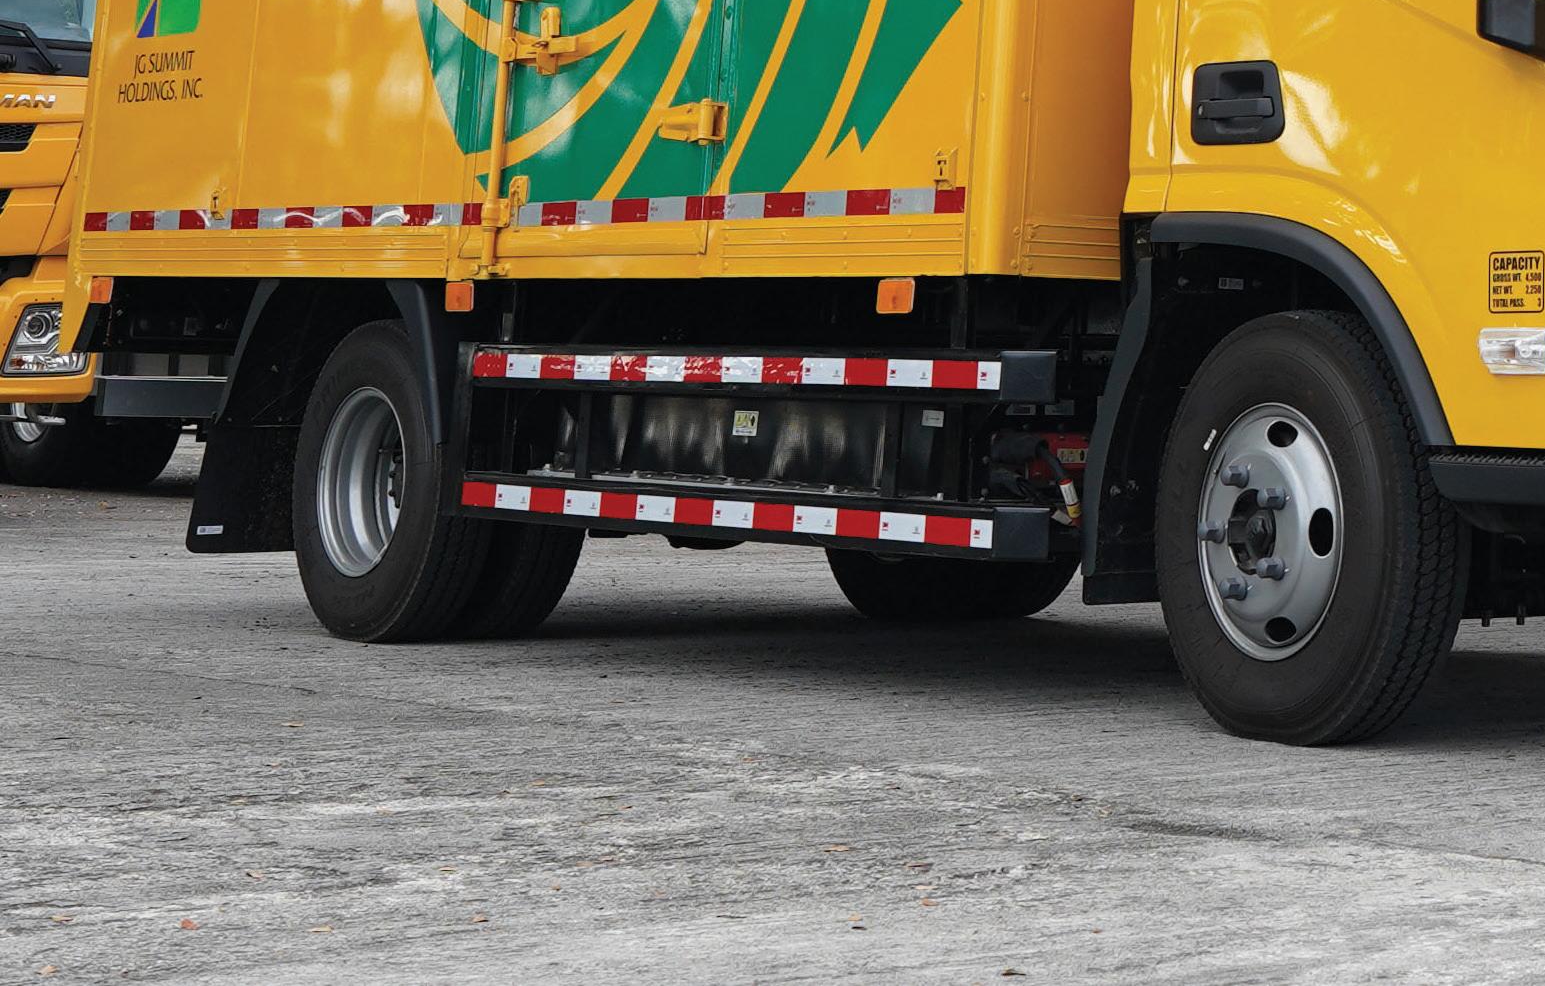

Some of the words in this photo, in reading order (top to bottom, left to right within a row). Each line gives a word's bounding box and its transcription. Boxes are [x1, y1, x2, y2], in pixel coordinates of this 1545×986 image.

[134, 53, 147, 79] JG
[148, 50, 196, 74] SUMMIT
[181, 78, 204, 99] INC.
[1493, 256, 1541, 271] CAPACITY
